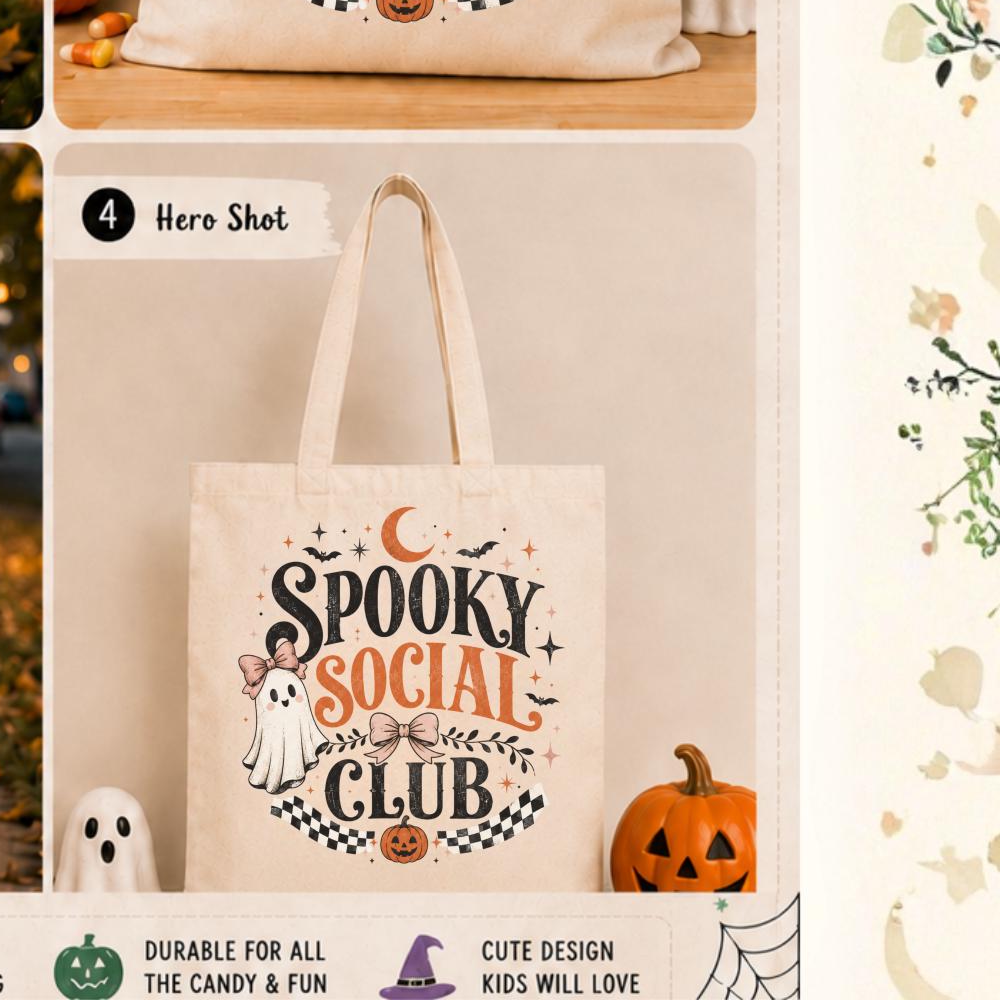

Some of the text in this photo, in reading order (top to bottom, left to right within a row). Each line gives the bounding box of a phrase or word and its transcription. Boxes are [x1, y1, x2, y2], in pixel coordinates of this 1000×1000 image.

[265, 561, 545, 665] SPOOKY
[314, 642, 543, 732] SOCIAL
[324, 757, 494, 822] CLUB
